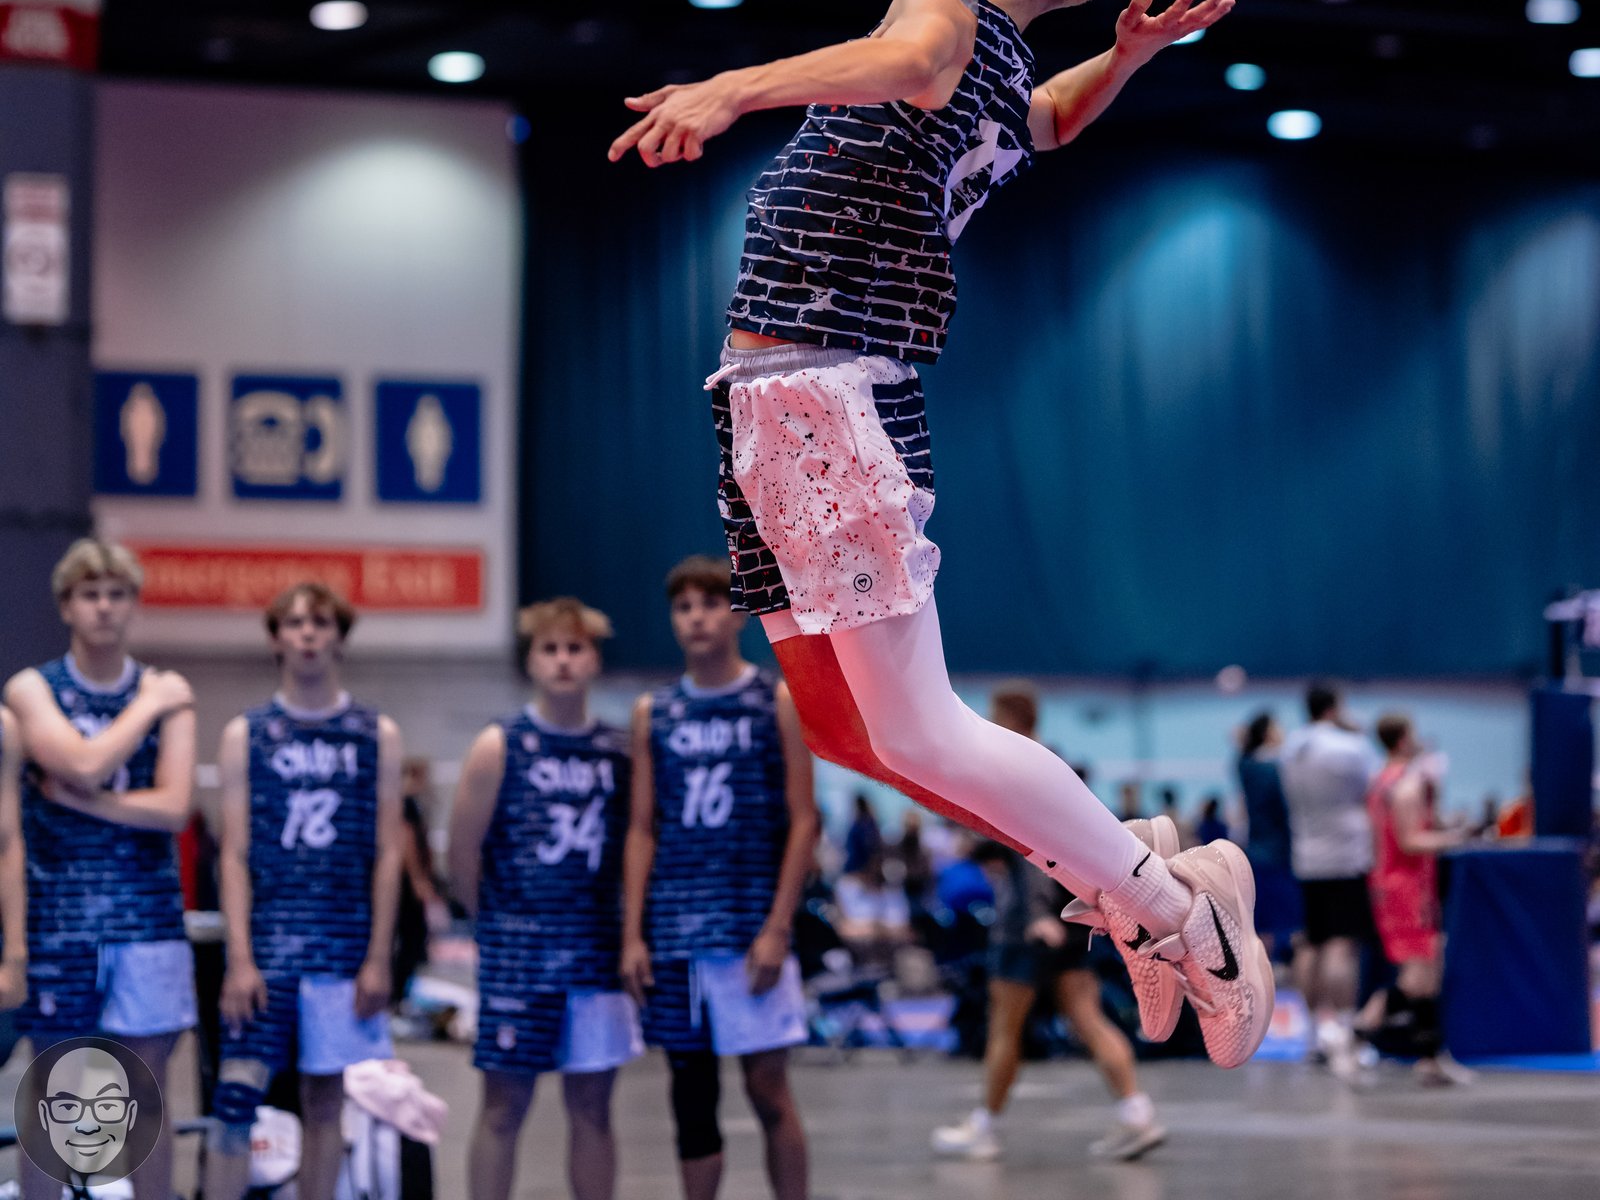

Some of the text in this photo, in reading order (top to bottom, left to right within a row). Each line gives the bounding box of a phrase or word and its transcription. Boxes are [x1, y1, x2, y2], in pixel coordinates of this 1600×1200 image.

[141, 555, 350, 606] mergency
[280, 788, 343, 850] 18
[681, 761, 734, 829] 16
[535, 796, 605, 872] 34
